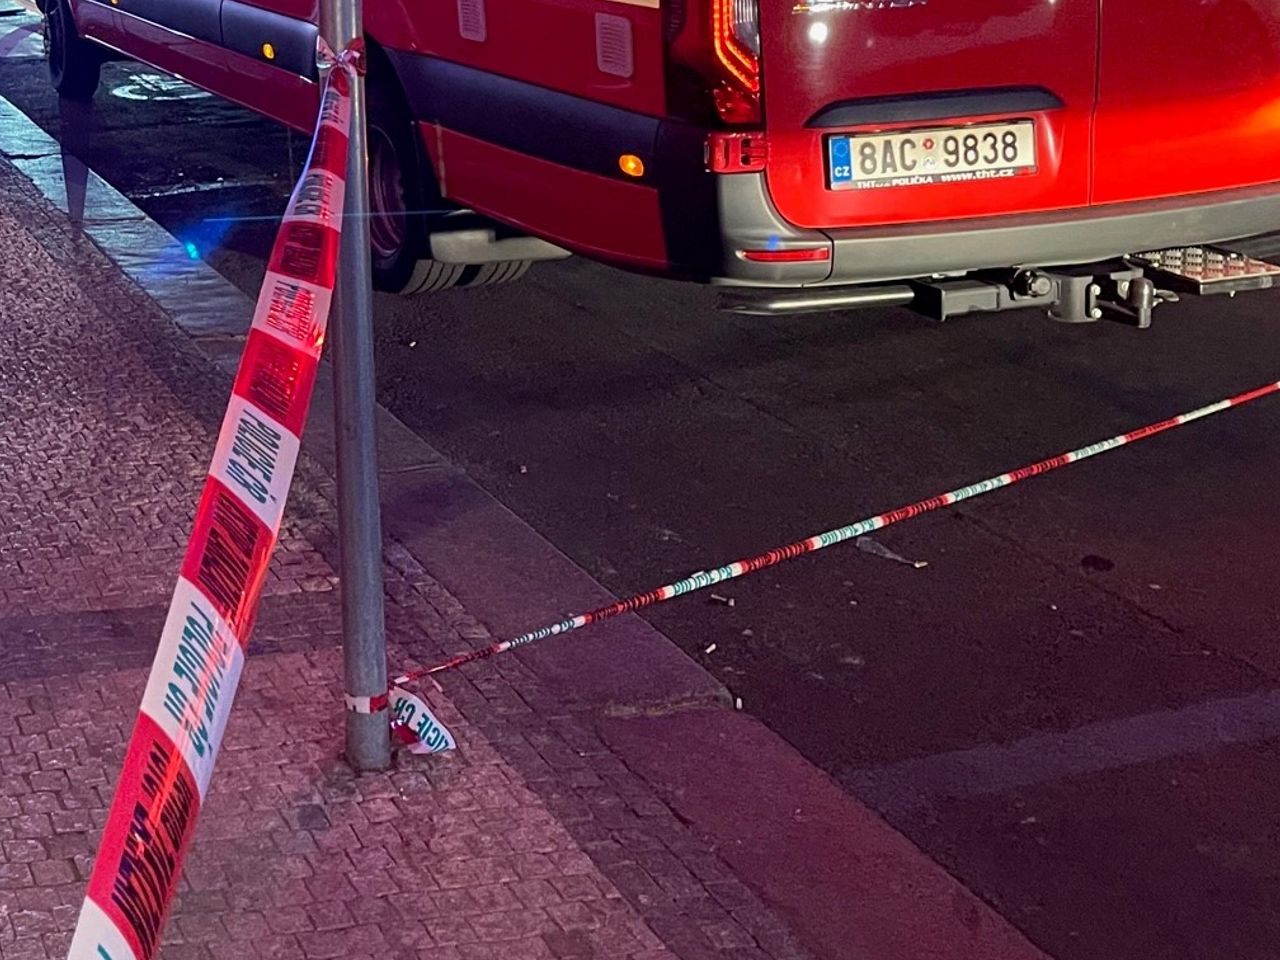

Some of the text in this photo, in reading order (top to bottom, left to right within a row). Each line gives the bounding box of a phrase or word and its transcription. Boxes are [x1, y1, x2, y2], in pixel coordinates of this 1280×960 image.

[859, 131, 1018, 175] 8AC 9838
[835, 166, 850, 177] CZ
[940, 169, 1015, 184] www.tht.cz
